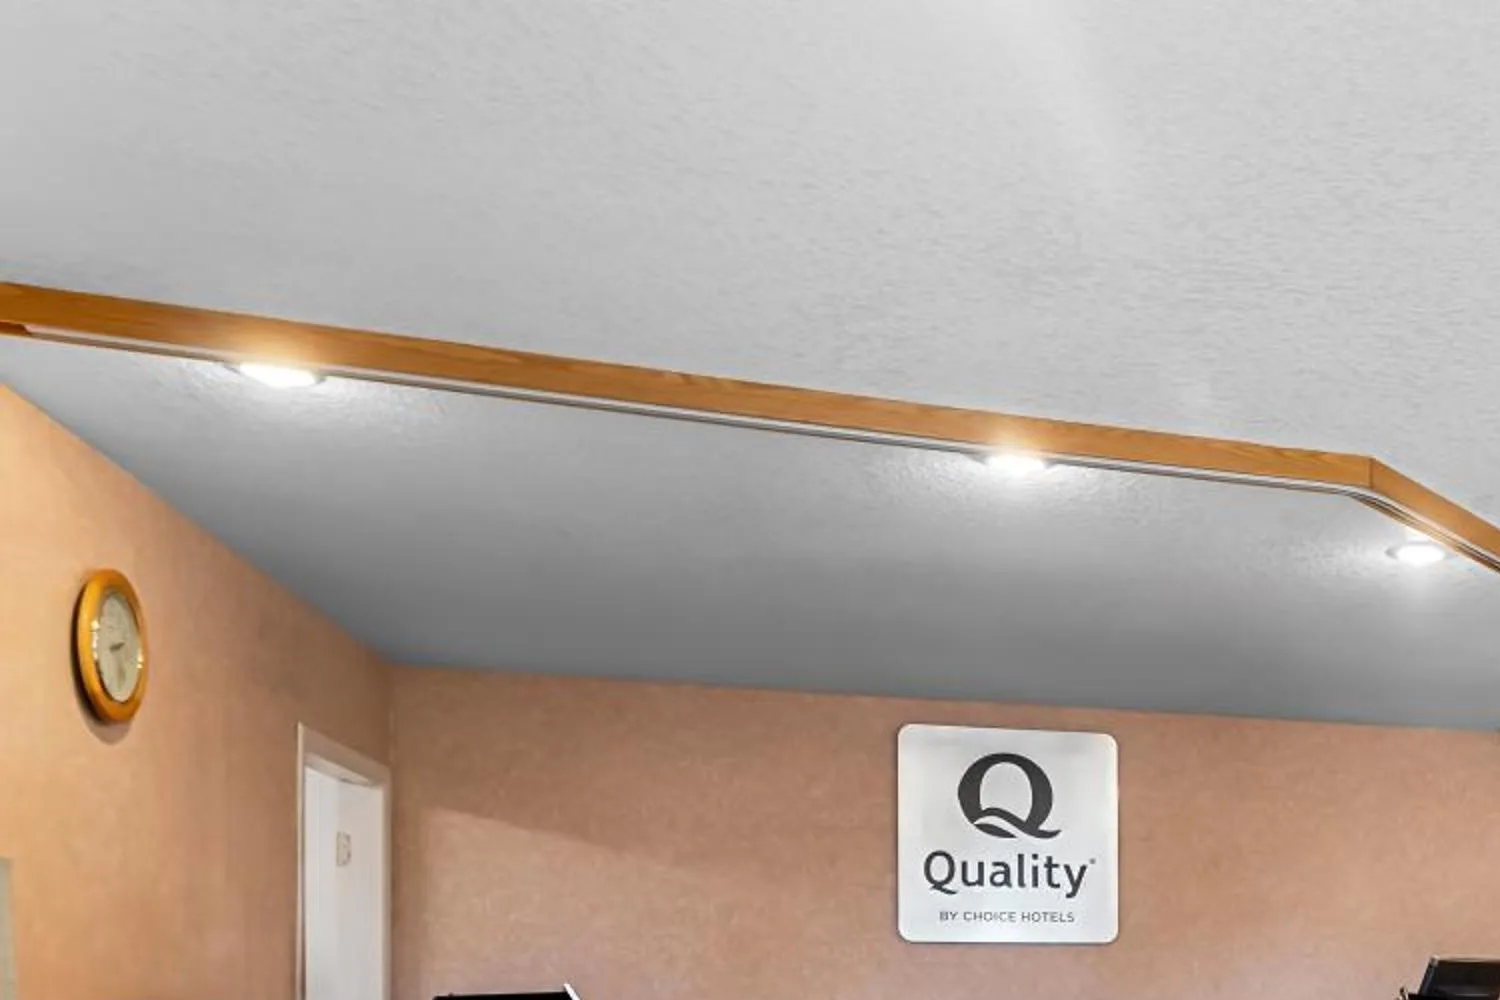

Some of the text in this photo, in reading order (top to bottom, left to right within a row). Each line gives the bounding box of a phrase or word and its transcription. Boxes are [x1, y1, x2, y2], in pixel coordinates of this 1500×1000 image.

[957, 751, 1062, 839] Q
[923, 850, 1088, 899] Quality
[939, 911, 1075, 924] BY CHOICE HOTELS
